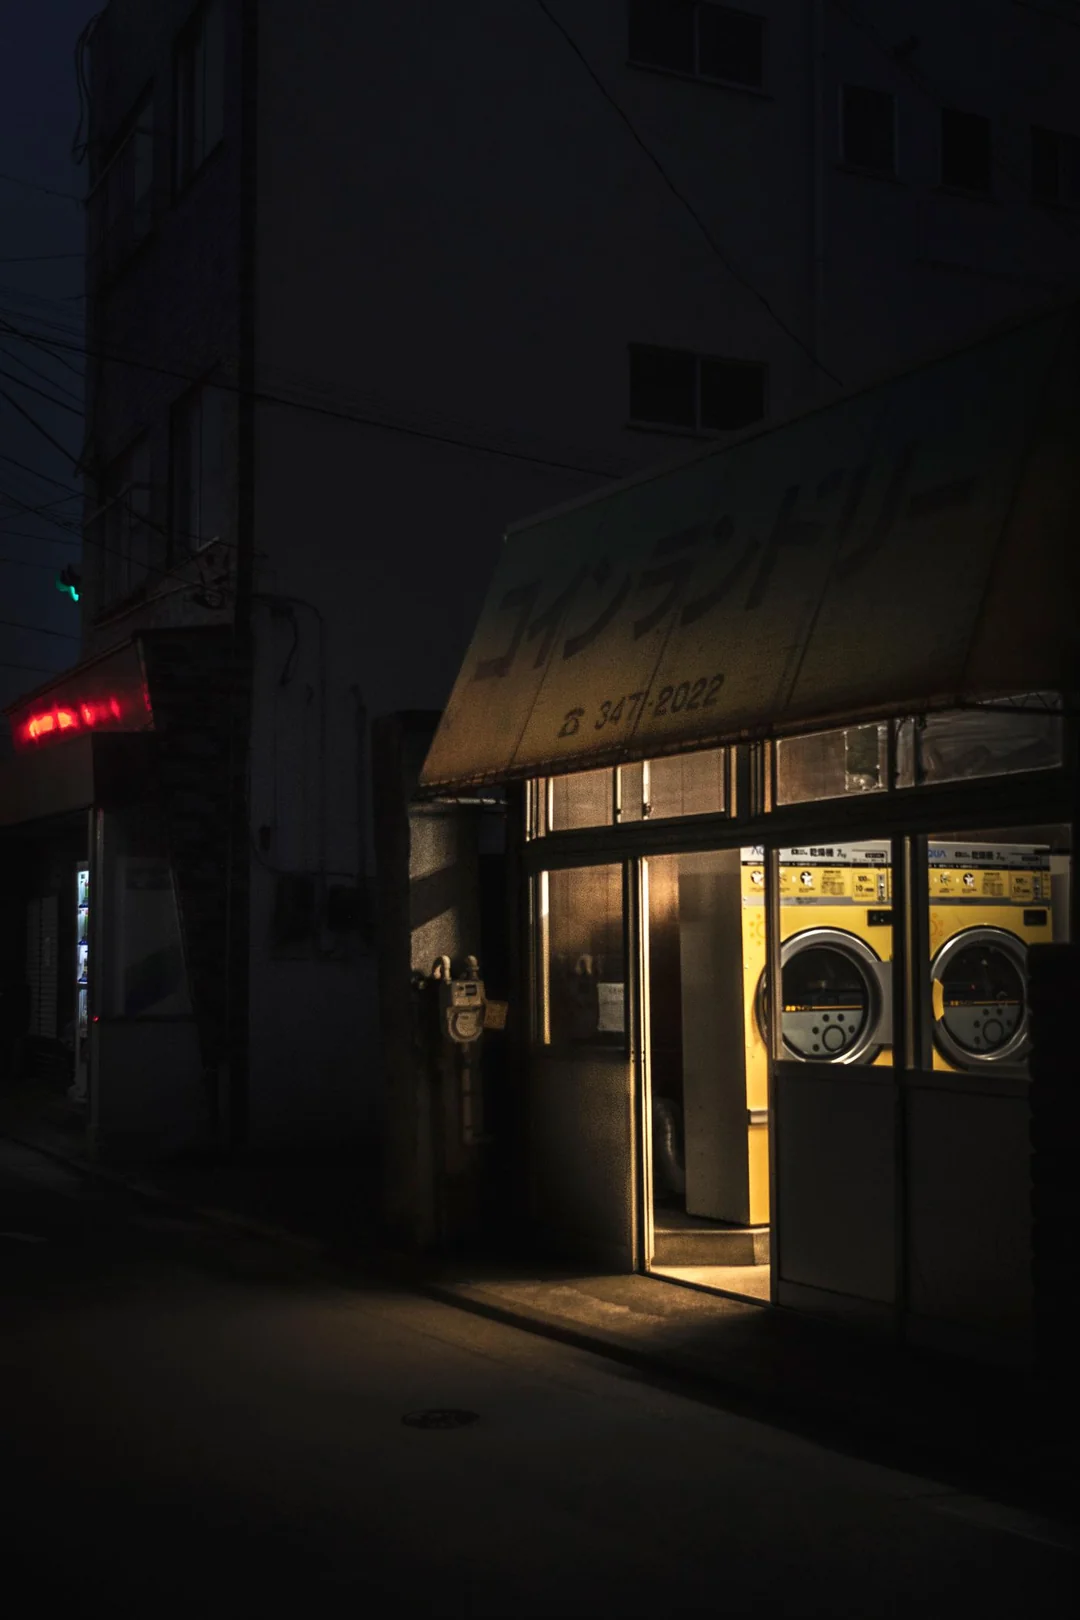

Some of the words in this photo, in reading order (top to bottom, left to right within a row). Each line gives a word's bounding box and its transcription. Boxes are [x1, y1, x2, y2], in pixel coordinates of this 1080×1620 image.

[472, 440, 976, 679] コインランドリー
